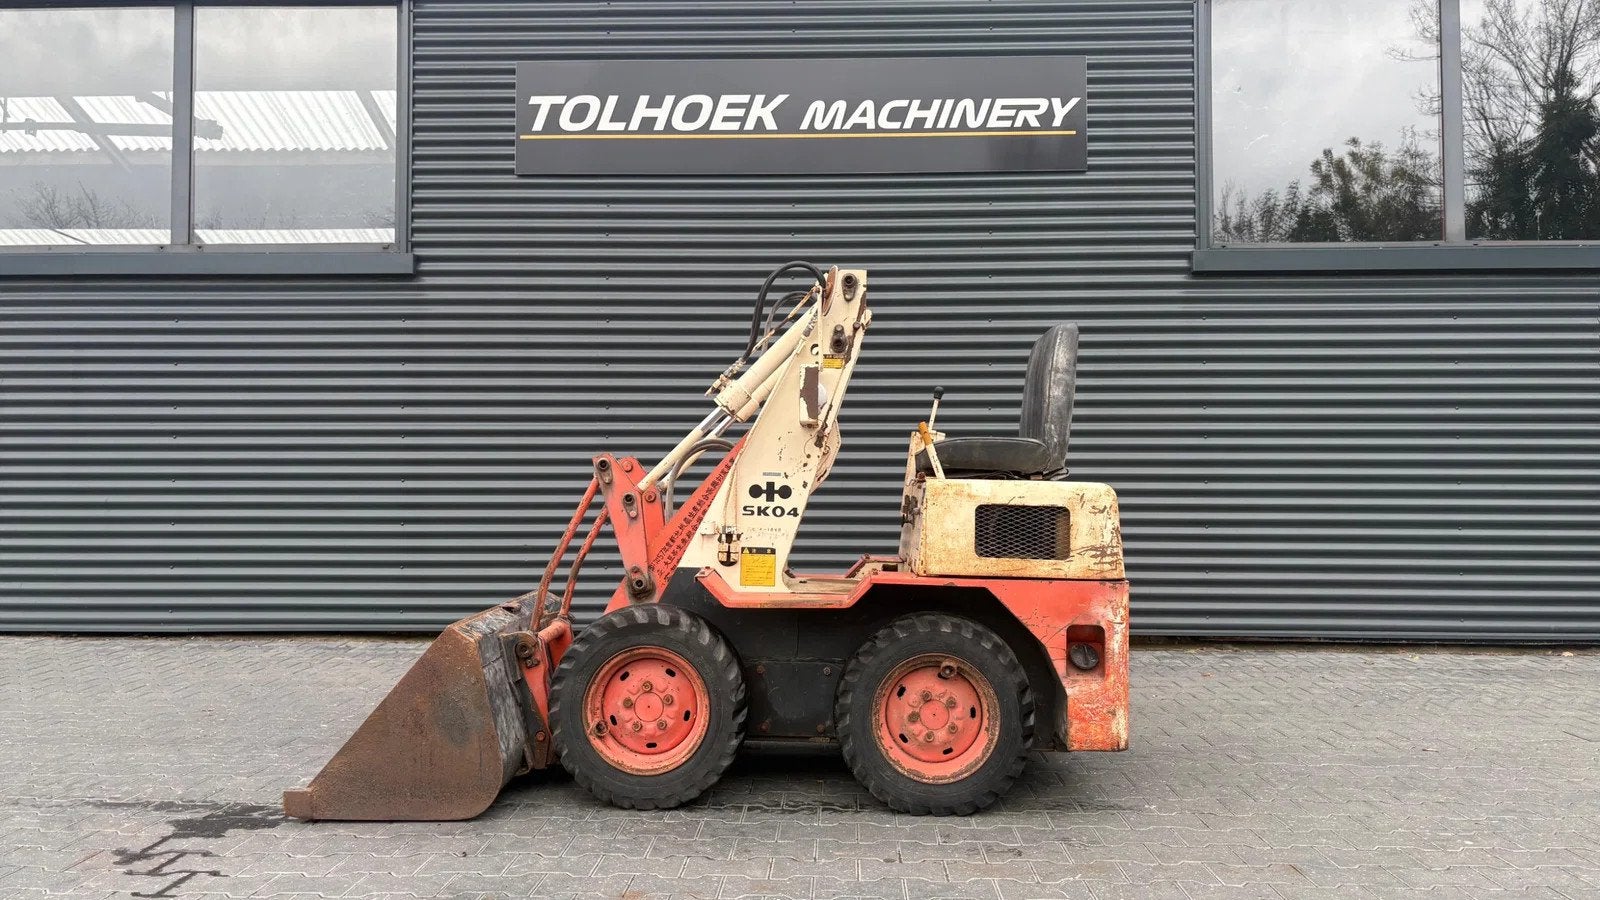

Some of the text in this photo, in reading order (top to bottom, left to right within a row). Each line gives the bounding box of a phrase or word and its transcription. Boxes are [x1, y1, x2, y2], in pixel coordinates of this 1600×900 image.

[528, 94, 1082, 131] TOLHOEK MACHINERY
[742, 505, 800, 518] SK04
